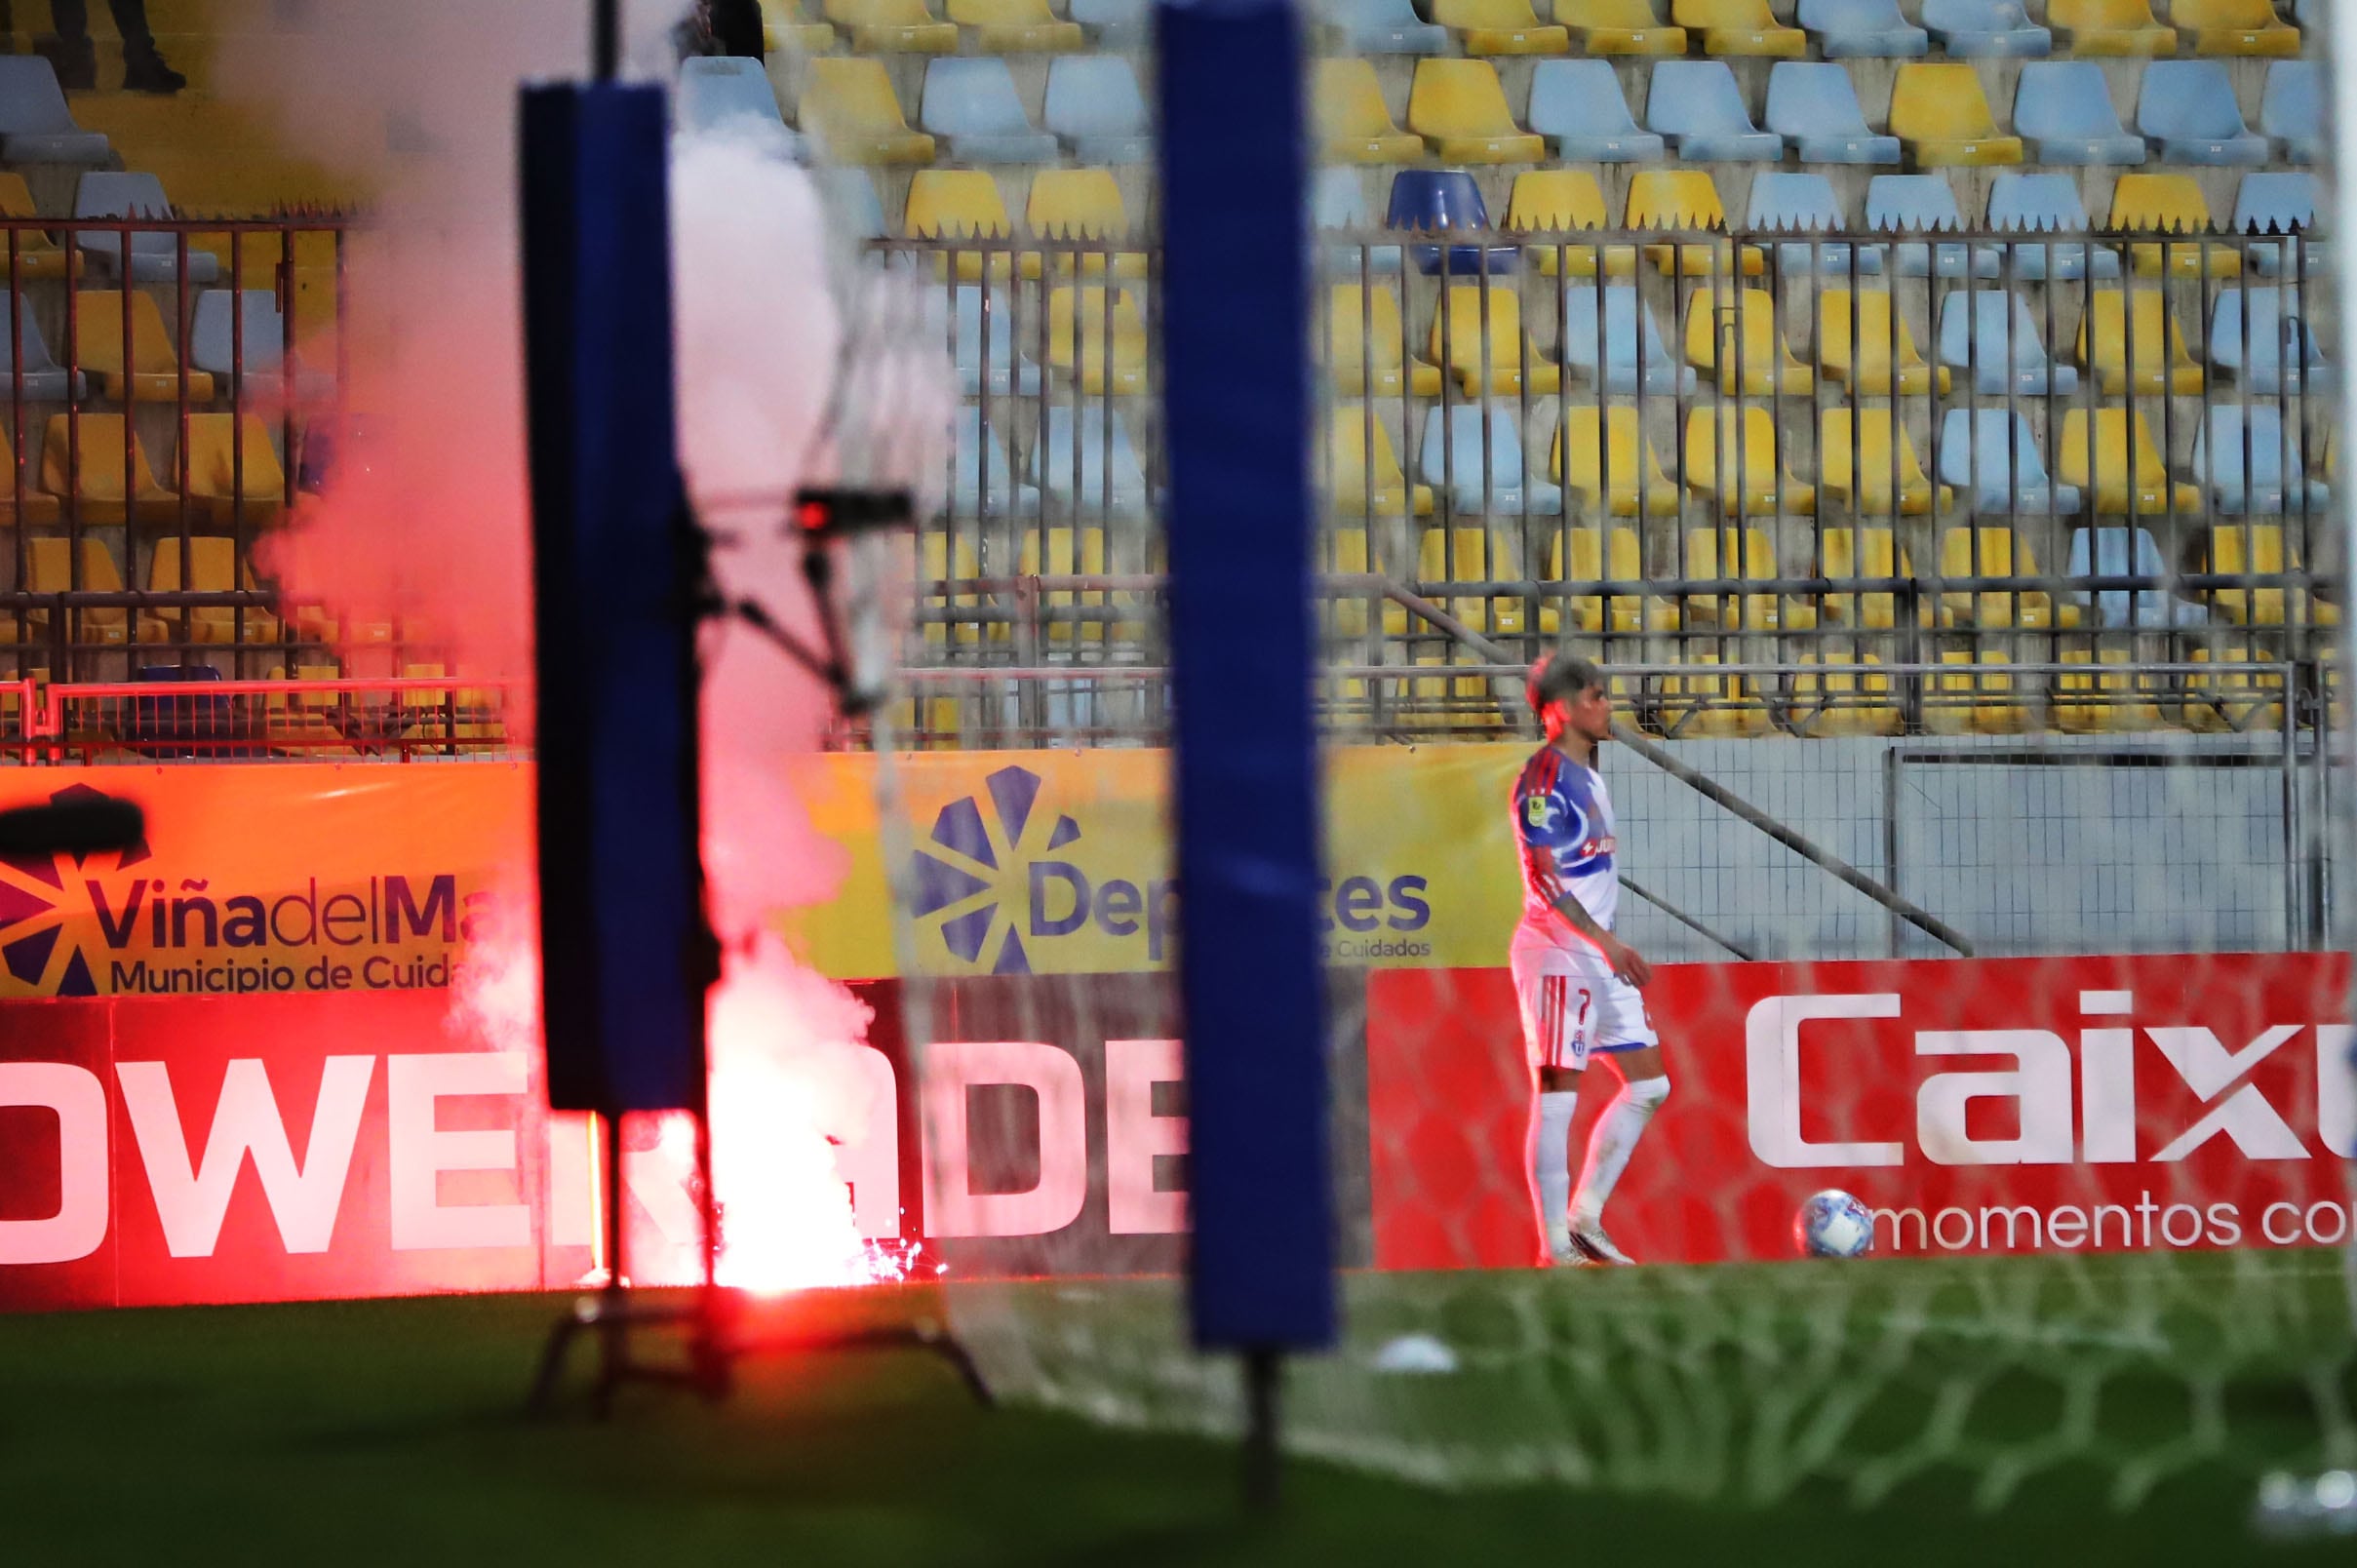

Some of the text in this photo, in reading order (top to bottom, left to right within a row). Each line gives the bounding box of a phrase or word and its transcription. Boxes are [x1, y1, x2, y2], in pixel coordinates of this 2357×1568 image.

[85, 875, 501, 950] ViñadelMa
[1029, 862, 1431, 960] Depes
[111, 959, 295, 994] Municipio
[305, 956, 354, 990] de
[1338, 938, 1432, 958] Cuidados
[1578, 988, 1591, 1026] 7
[1746, 990, 2357, 1168] Caix
[1867, 1191, 2357, 1251] momentos co
